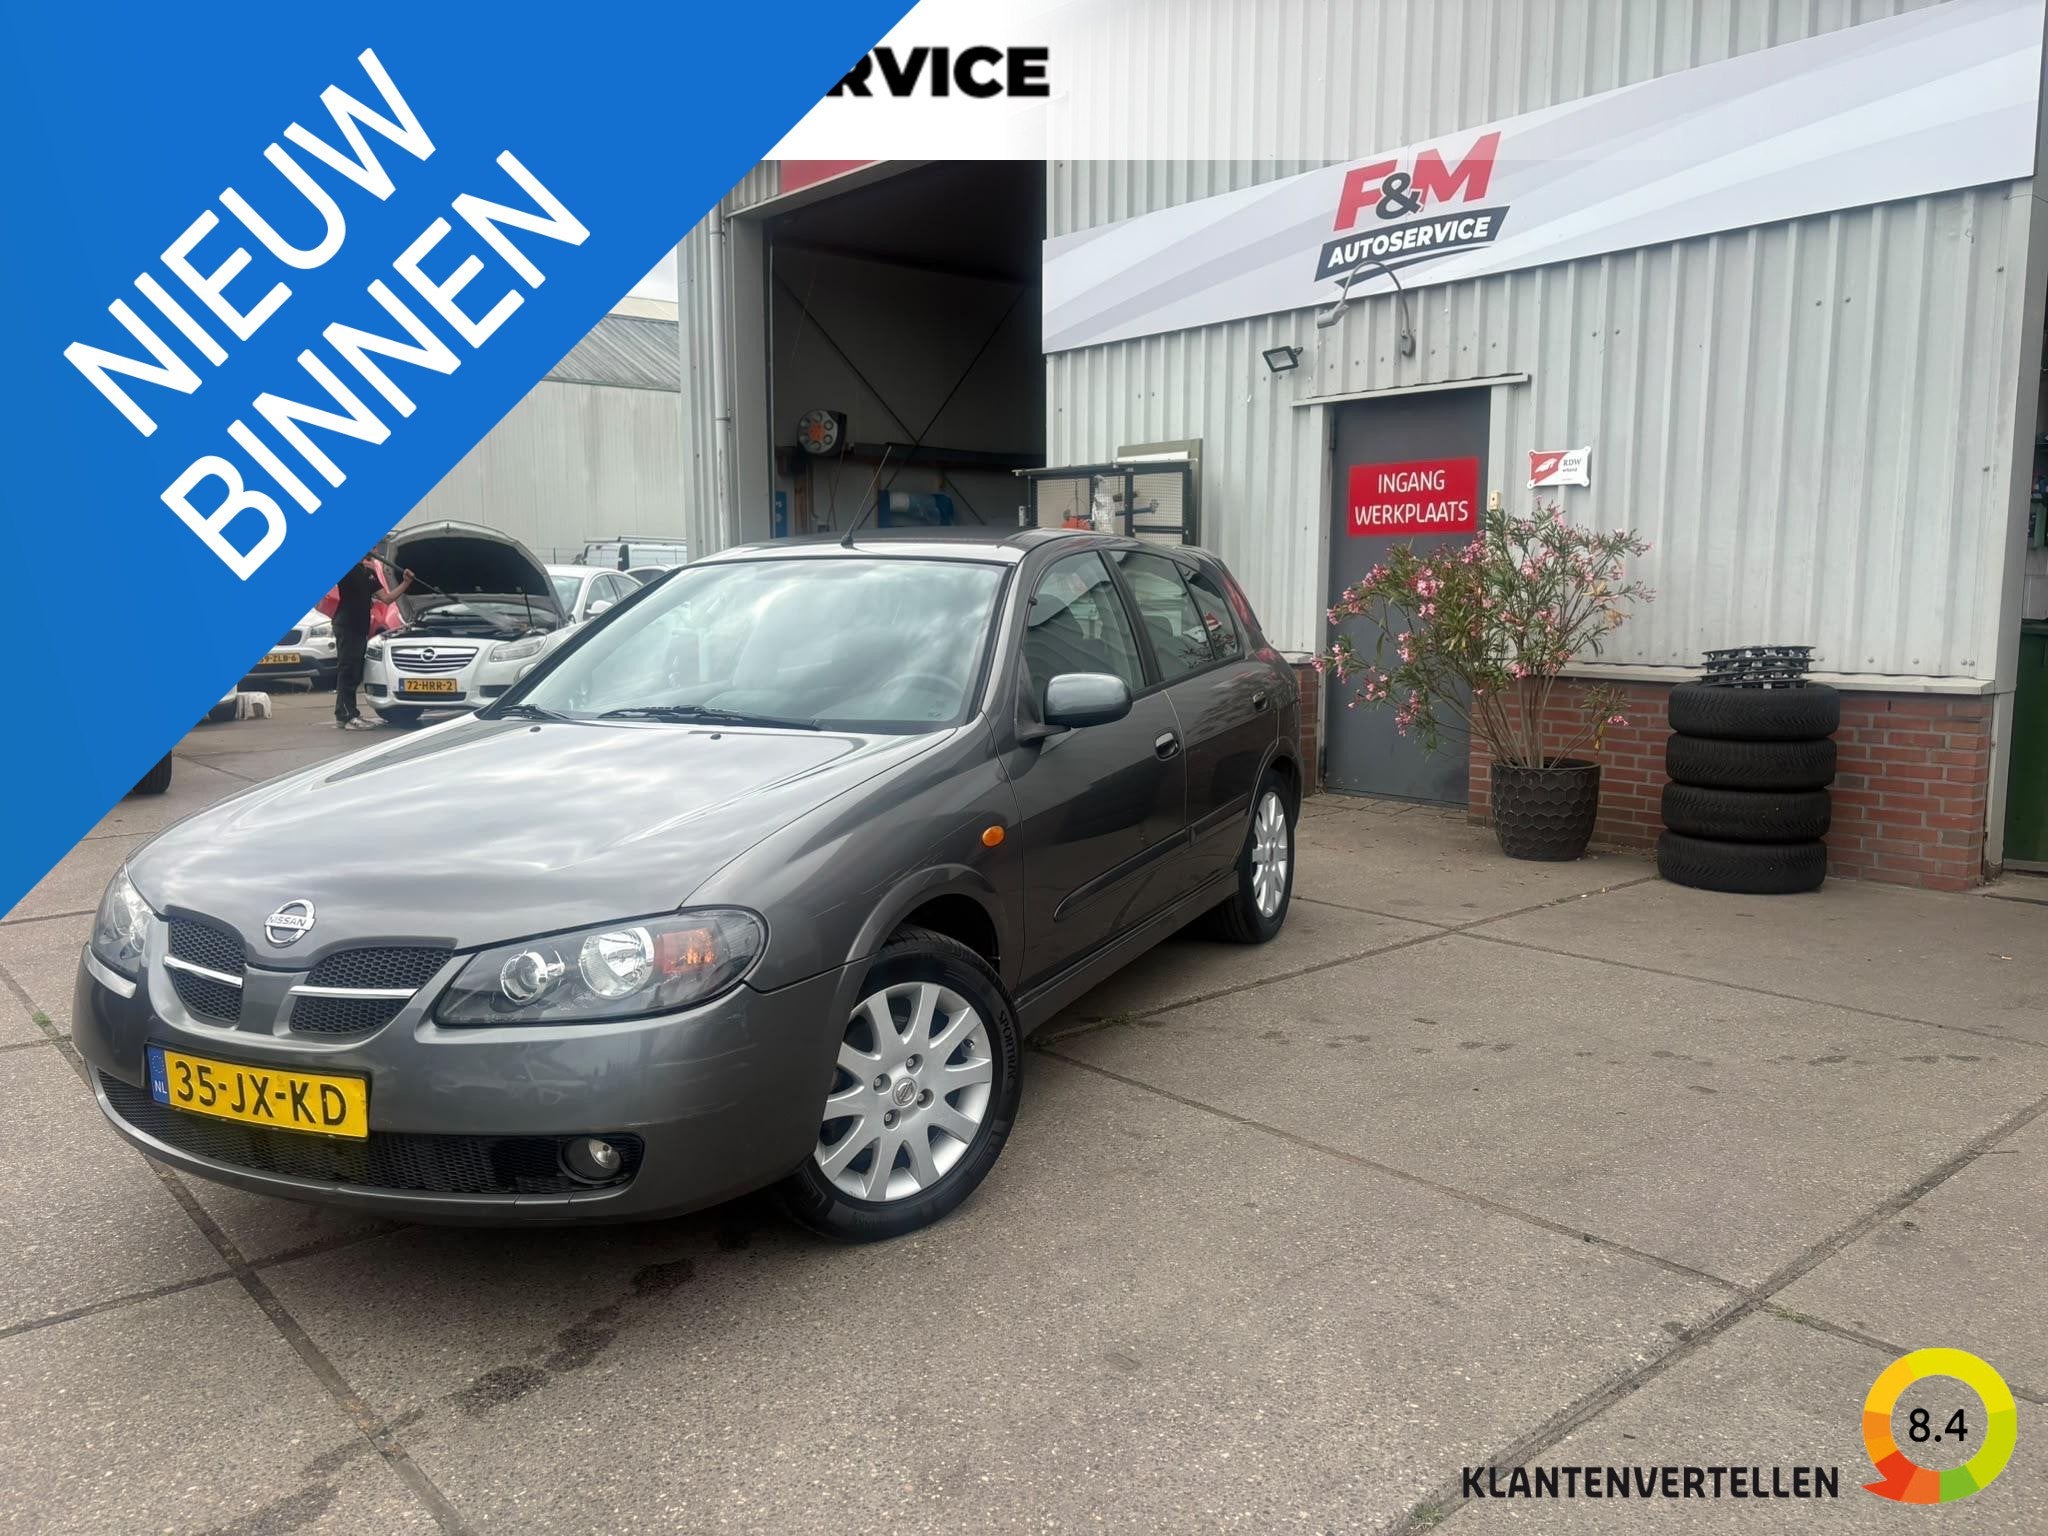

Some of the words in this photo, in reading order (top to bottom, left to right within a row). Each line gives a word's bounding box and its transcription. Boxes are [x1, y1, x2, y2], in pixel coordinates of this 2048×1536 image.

[1333, 131, 1501, 232] F&M
[1327, 216, 1492, 268] AUTOSERVICE
[1563, 458, 1582, 467] RDW
[1378, 470, 1446, 494] INGANG
[1354, 500, 1469, 526] WERKPLAATS
[269, 915, 307, 927] NISSAN
[154, 1081, 167, 1093] NL
[175, 1060, 347, 1126] 35-JX-KD
